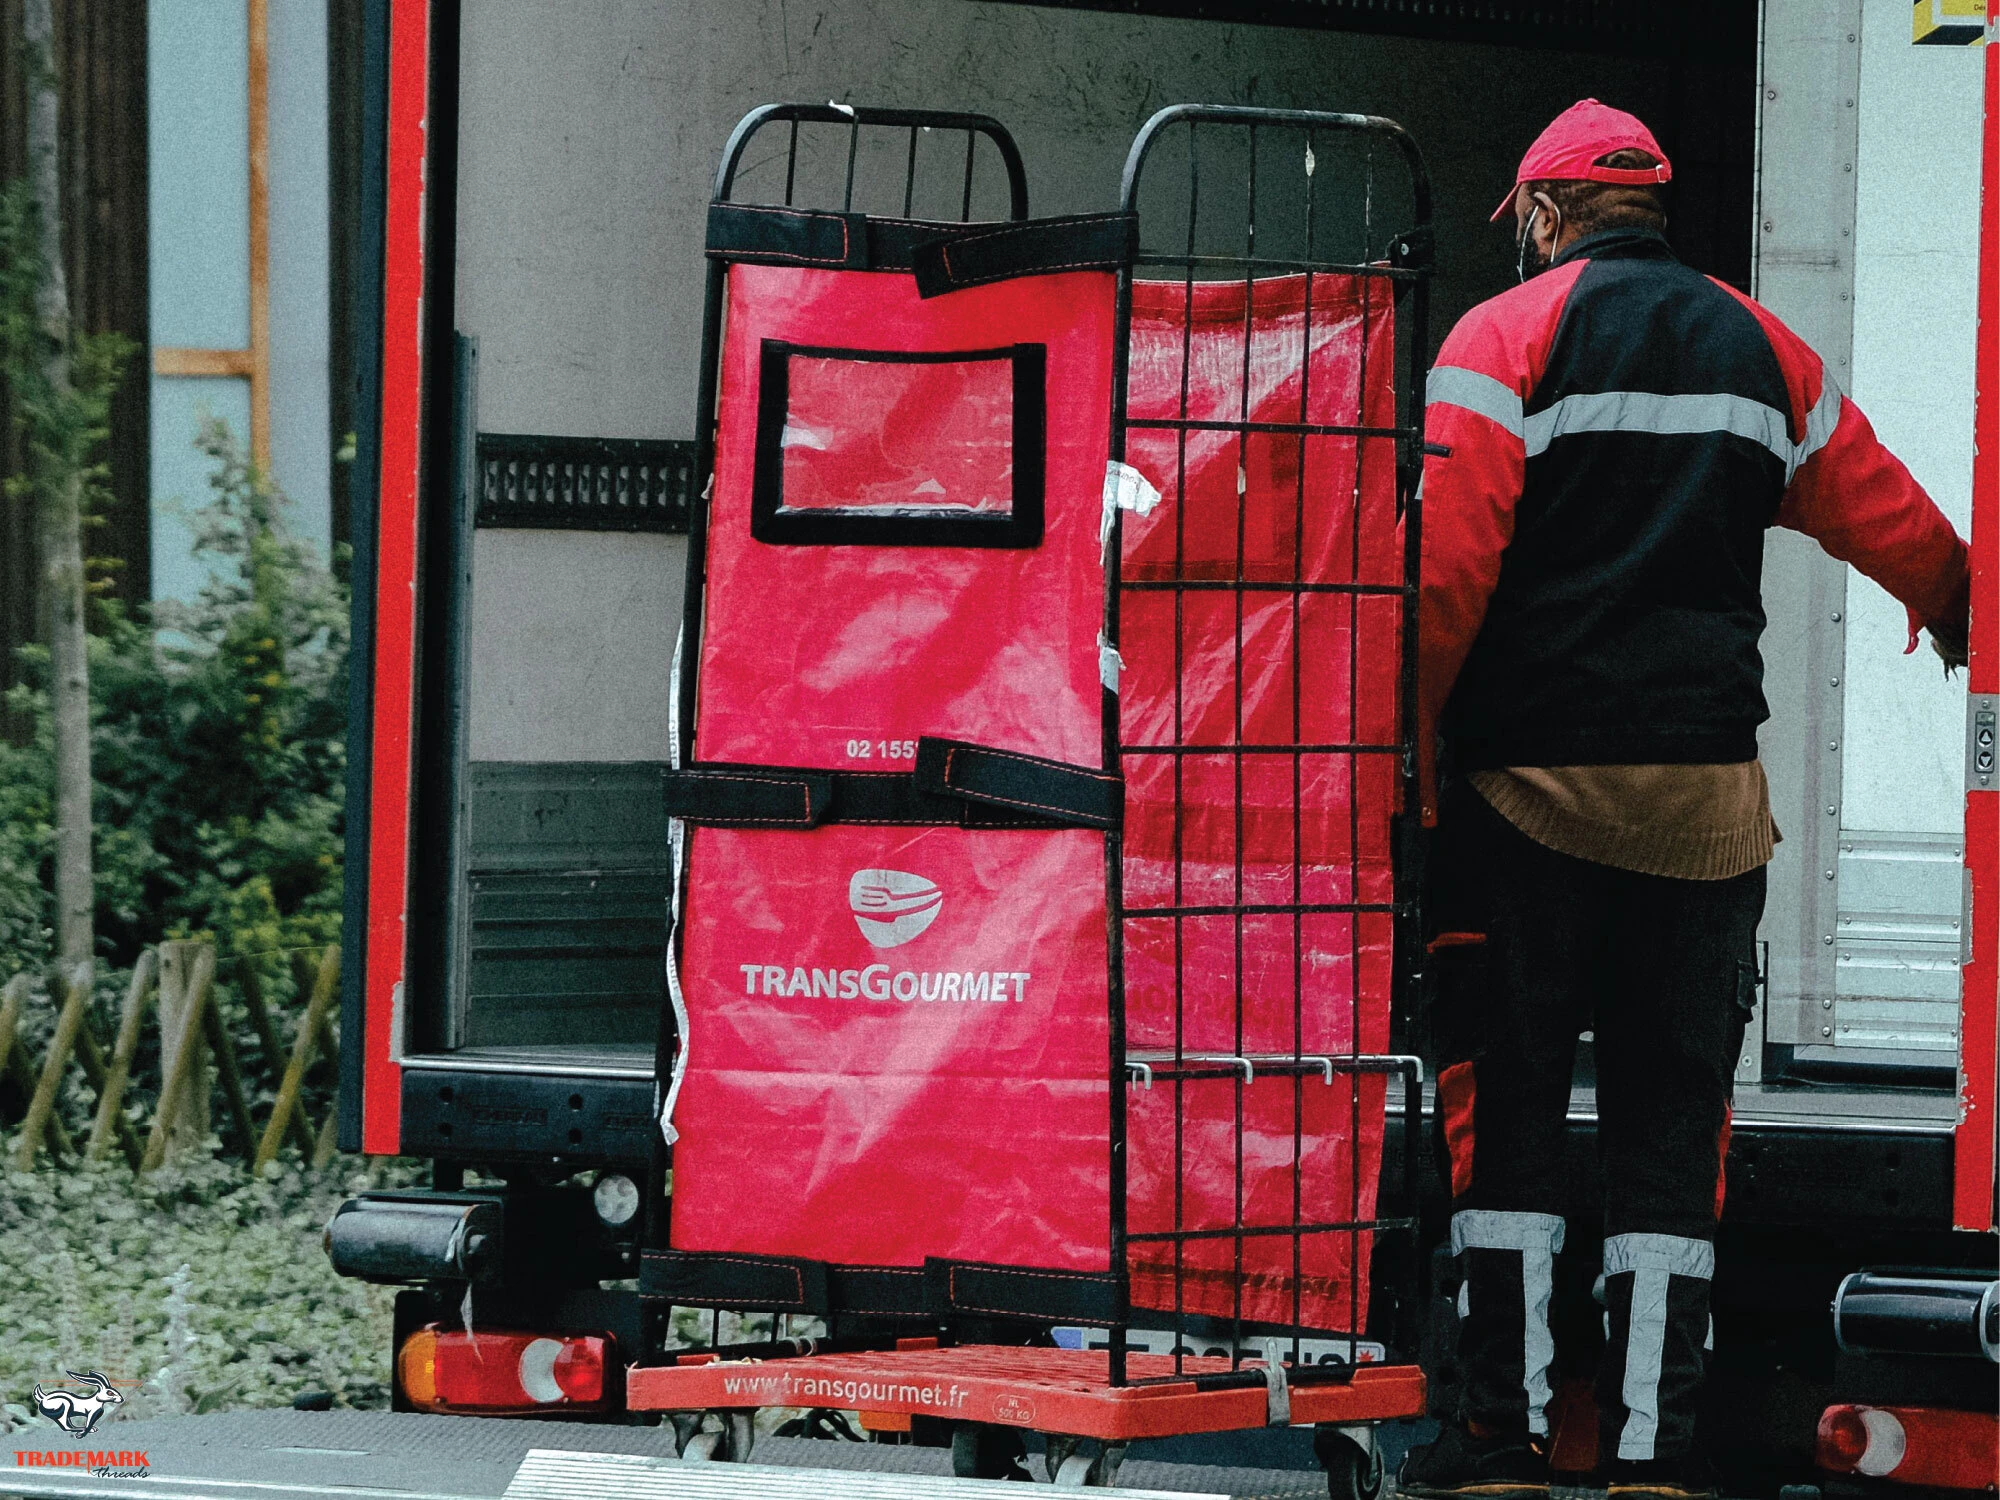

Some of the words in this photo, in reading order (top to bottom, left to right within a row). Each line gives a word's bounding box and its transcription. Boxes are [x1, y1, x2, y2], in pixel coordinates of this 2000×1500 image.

[846, 739, 871, 758] 02
[740, 963, 1031, 1002] TRANSGOURMET
[723, 1372, 968, 1407] wwwtransgourmet.fr
